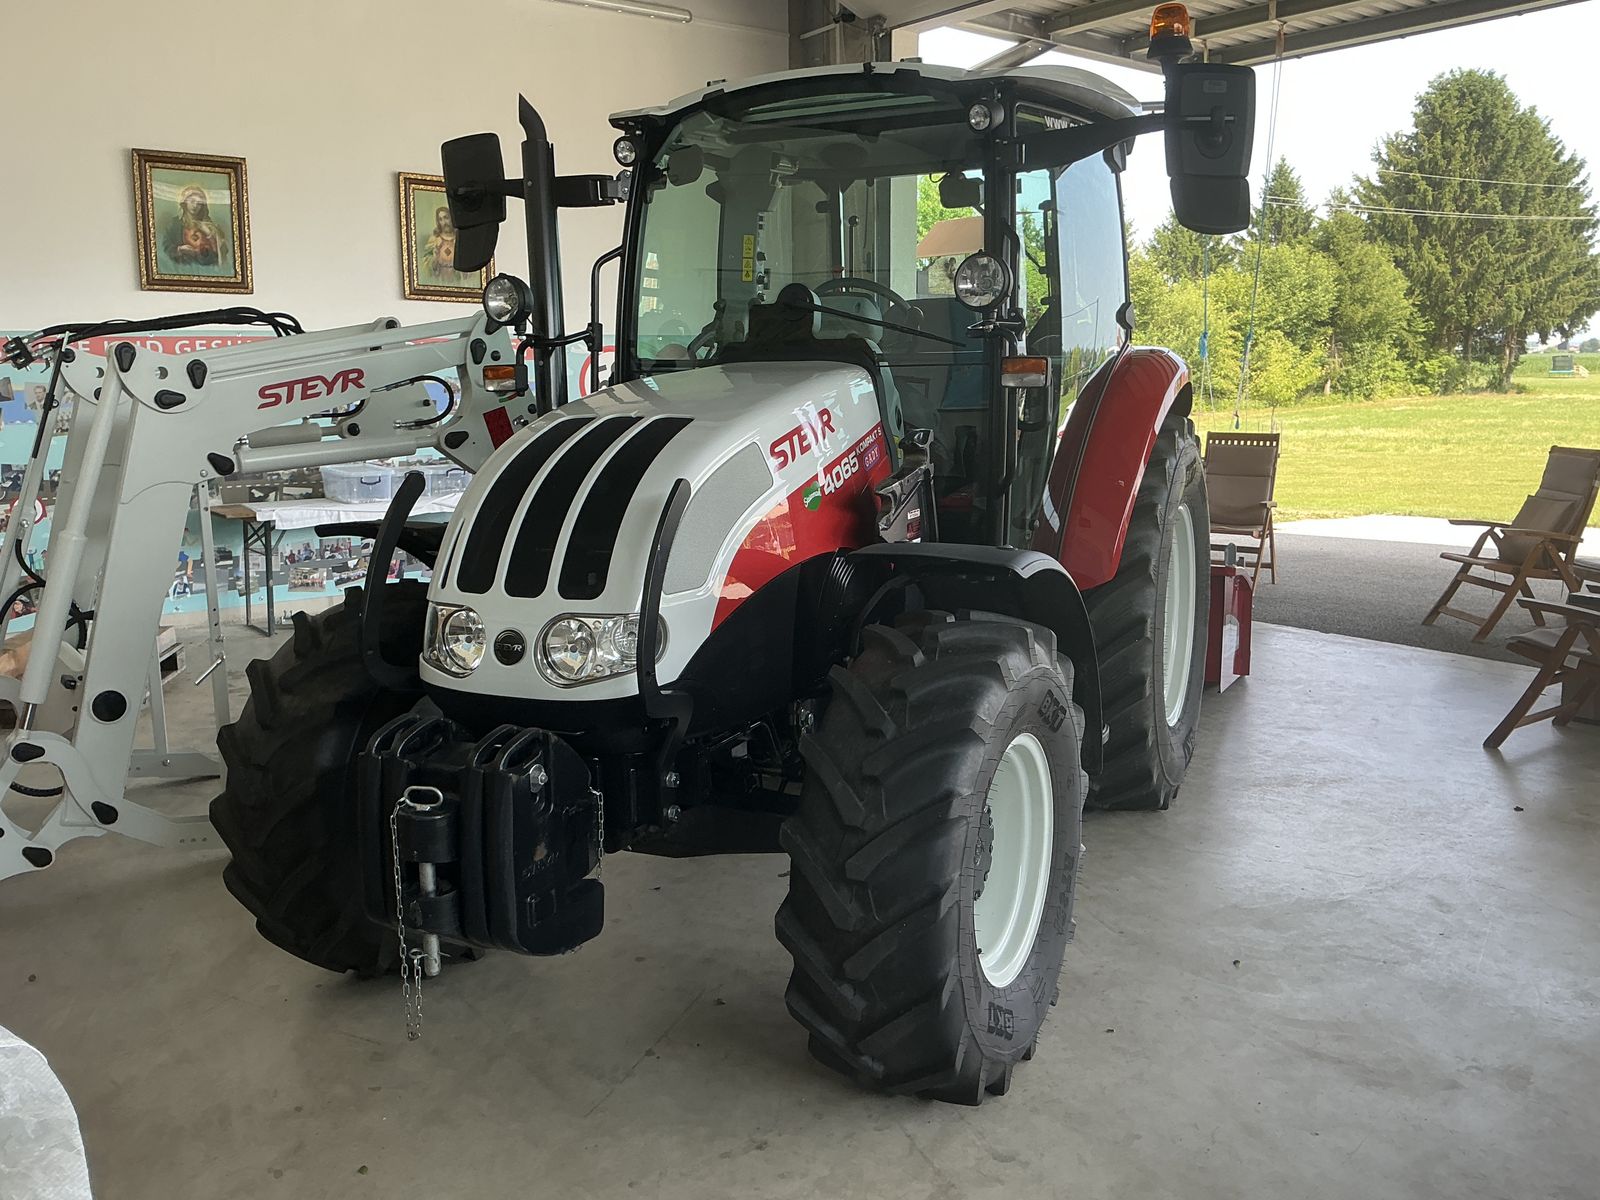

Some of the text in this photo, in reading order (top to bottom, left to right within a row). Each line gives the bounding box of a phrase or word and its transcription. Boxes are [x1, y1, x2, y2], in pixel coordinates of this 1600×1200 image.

[257, 368, 366, 410] STEYR
[769, 408, 836, 473] STEYR
[824, 451, 859, 496] 4065
[1039, 689, 1067, 733] BKT
